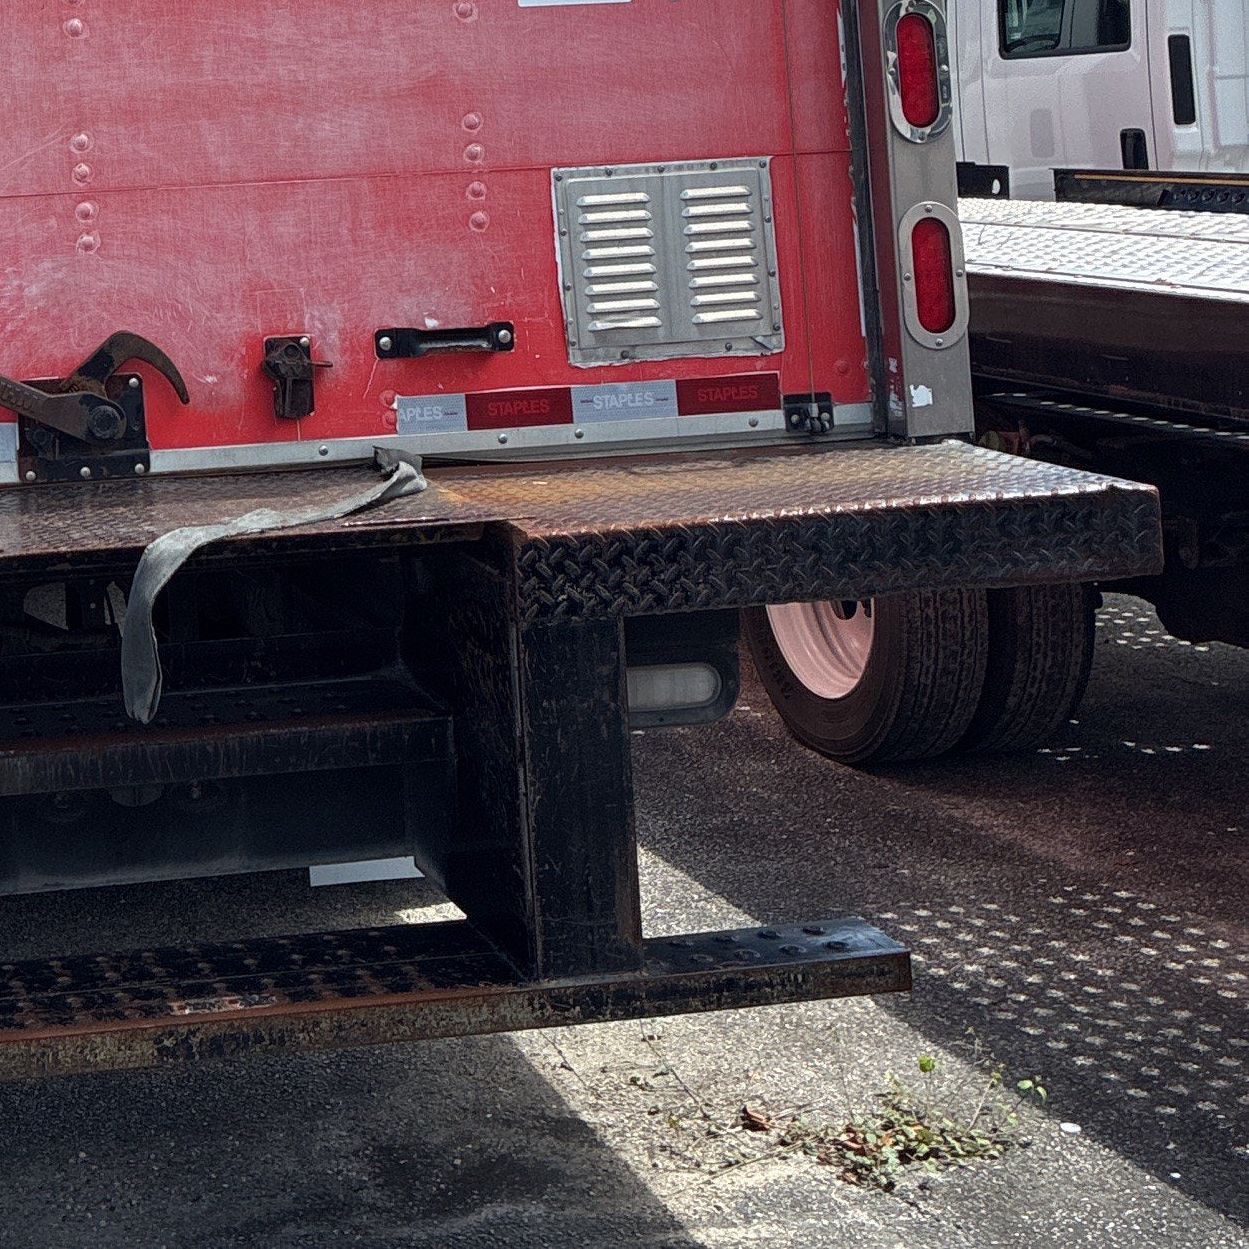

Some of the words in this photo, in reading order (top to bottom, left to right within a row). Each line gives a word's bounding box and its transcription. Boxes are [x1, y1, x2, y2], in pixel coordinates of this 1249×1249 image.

[487, 399, 550, 417] STAPLES
[592, 391, 655, 410] STAPLES
[697, 385, 759, 402] STAPLES
